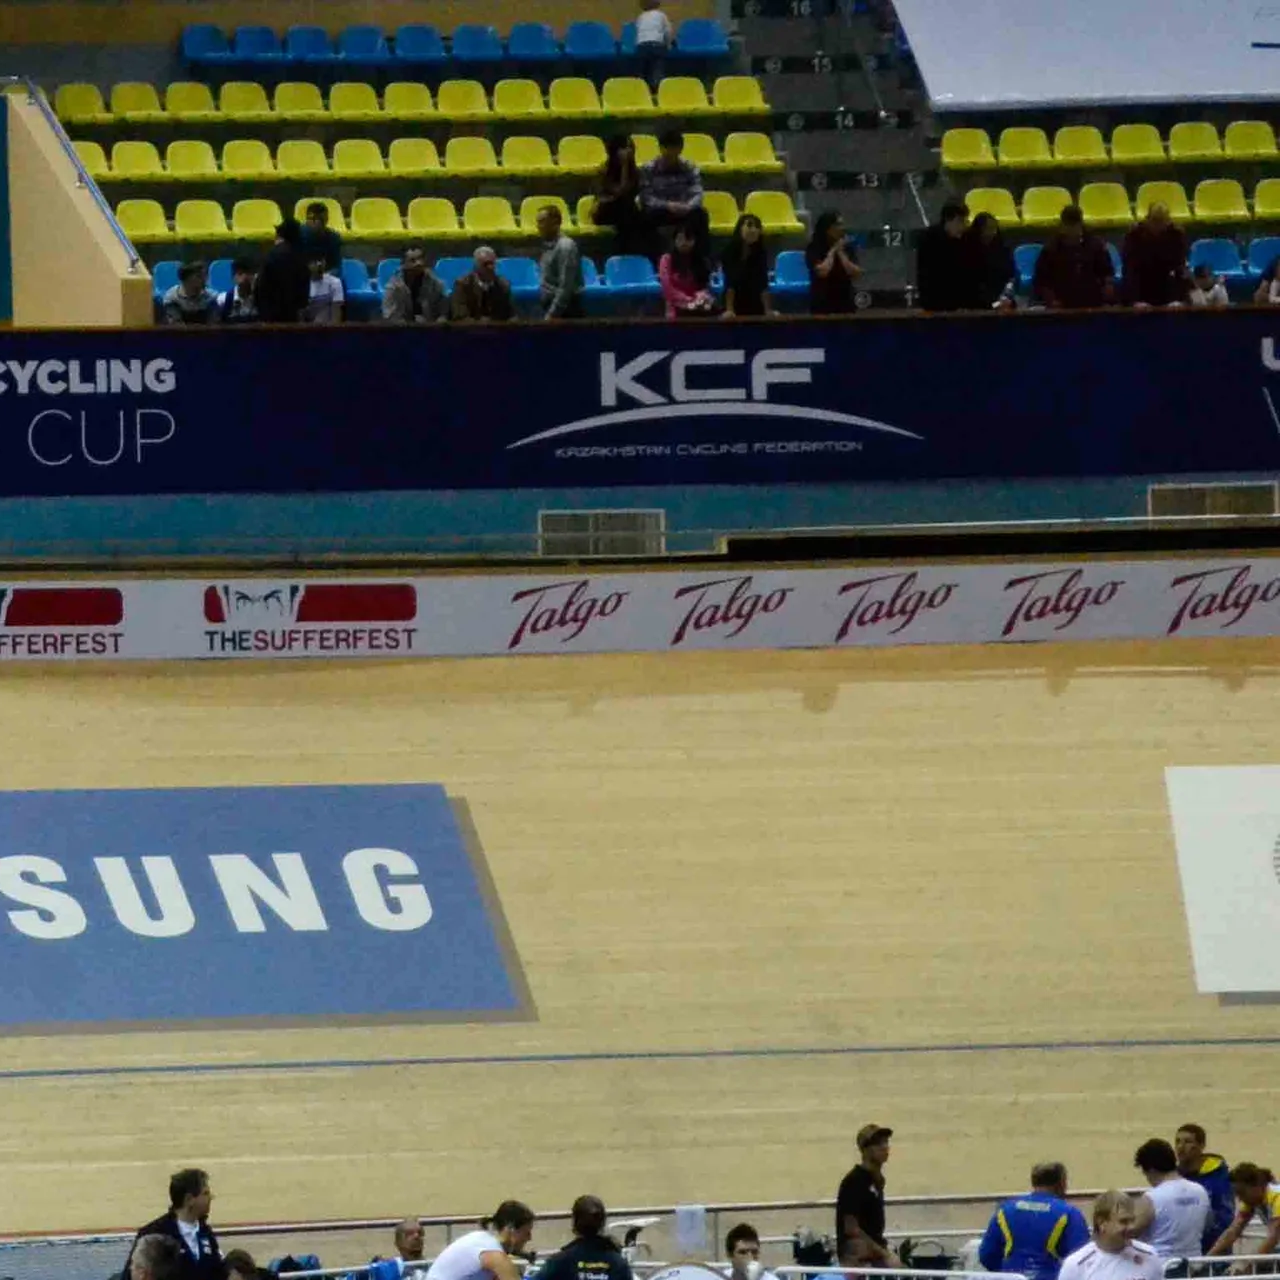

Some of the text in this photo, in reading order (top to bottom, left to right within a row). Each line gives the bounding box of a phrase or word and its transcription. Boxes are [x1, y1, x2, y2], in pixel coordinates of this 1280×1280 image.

[811, 57, 832, 73] 15
[834, 113, 855, 128] 14
[857, 172, 879, 188] 13
[883, 230, 902, 247] 12
[600, 348, 825, 406] KCF
[28, 411, 177, 467] CUP
[675, 443, 748, 456] CYCLING
[754, 440, 864, 454] FEDERATION
[508, 564, 1280, 650] Talgo Talgo Talgo Talgo Talgo
[204, 627, 418, 652] THESUFFERFEST
